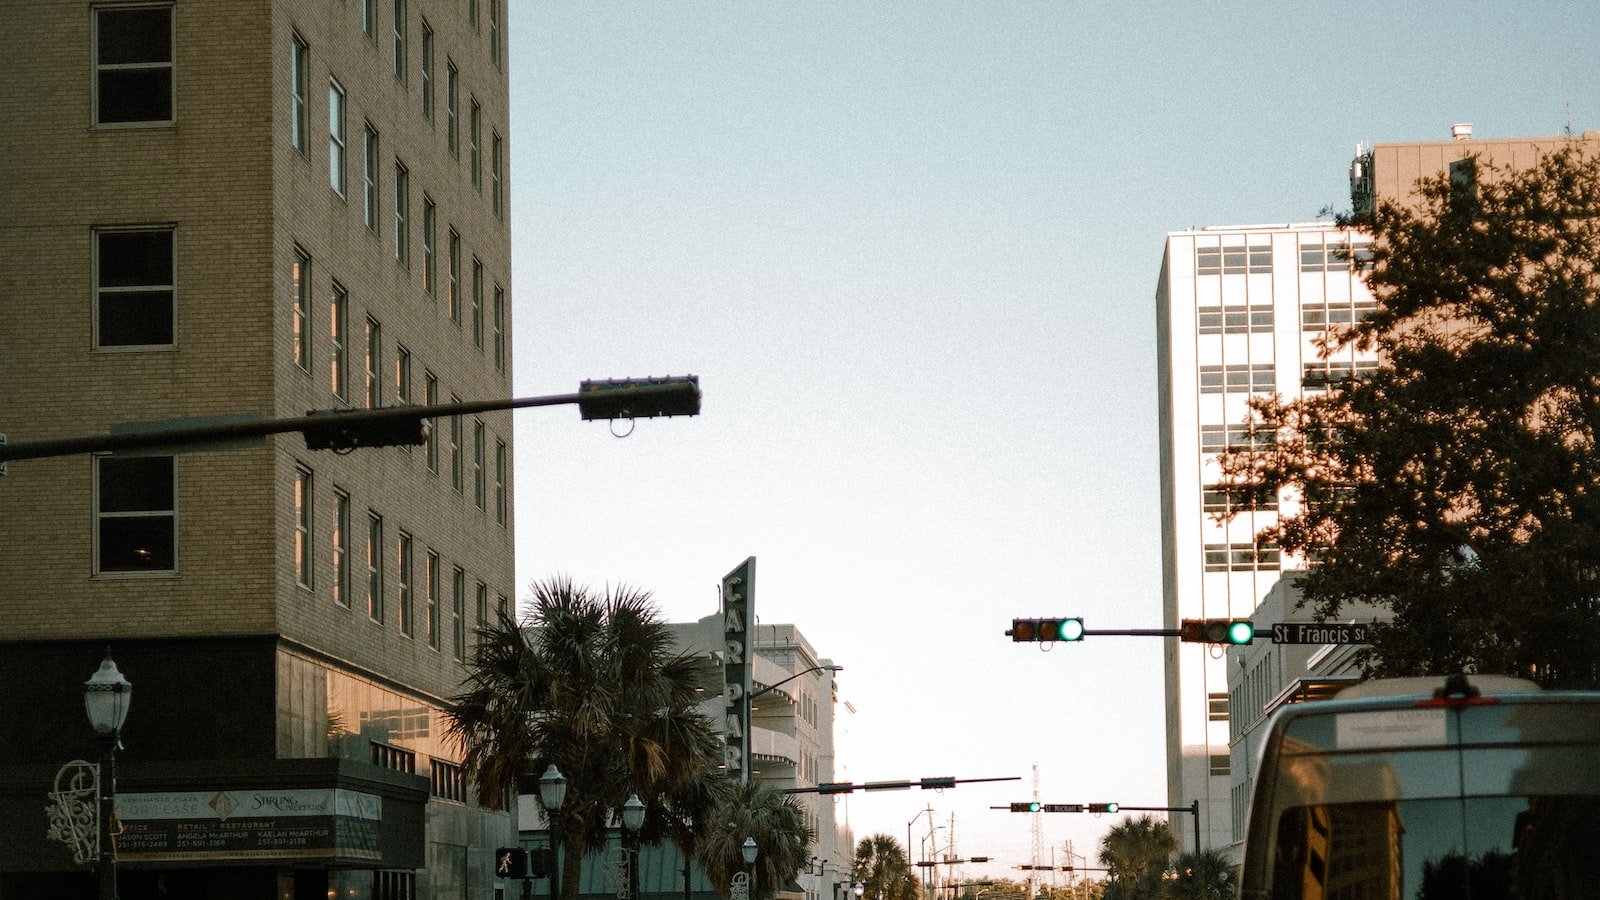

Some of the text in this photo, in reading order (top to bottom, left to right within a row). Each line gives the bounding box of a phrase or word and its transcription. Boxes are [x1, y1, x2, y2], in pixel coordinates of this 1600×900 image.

[1274, 624, 1365, 643] St Francis St
[724, 576, 744, 770] CAR PAR
[121, 804, 198, 815] FOR LEASE
[118, 833, 142, 841] JASON
[177, 832, 207, 840] ANGELA
